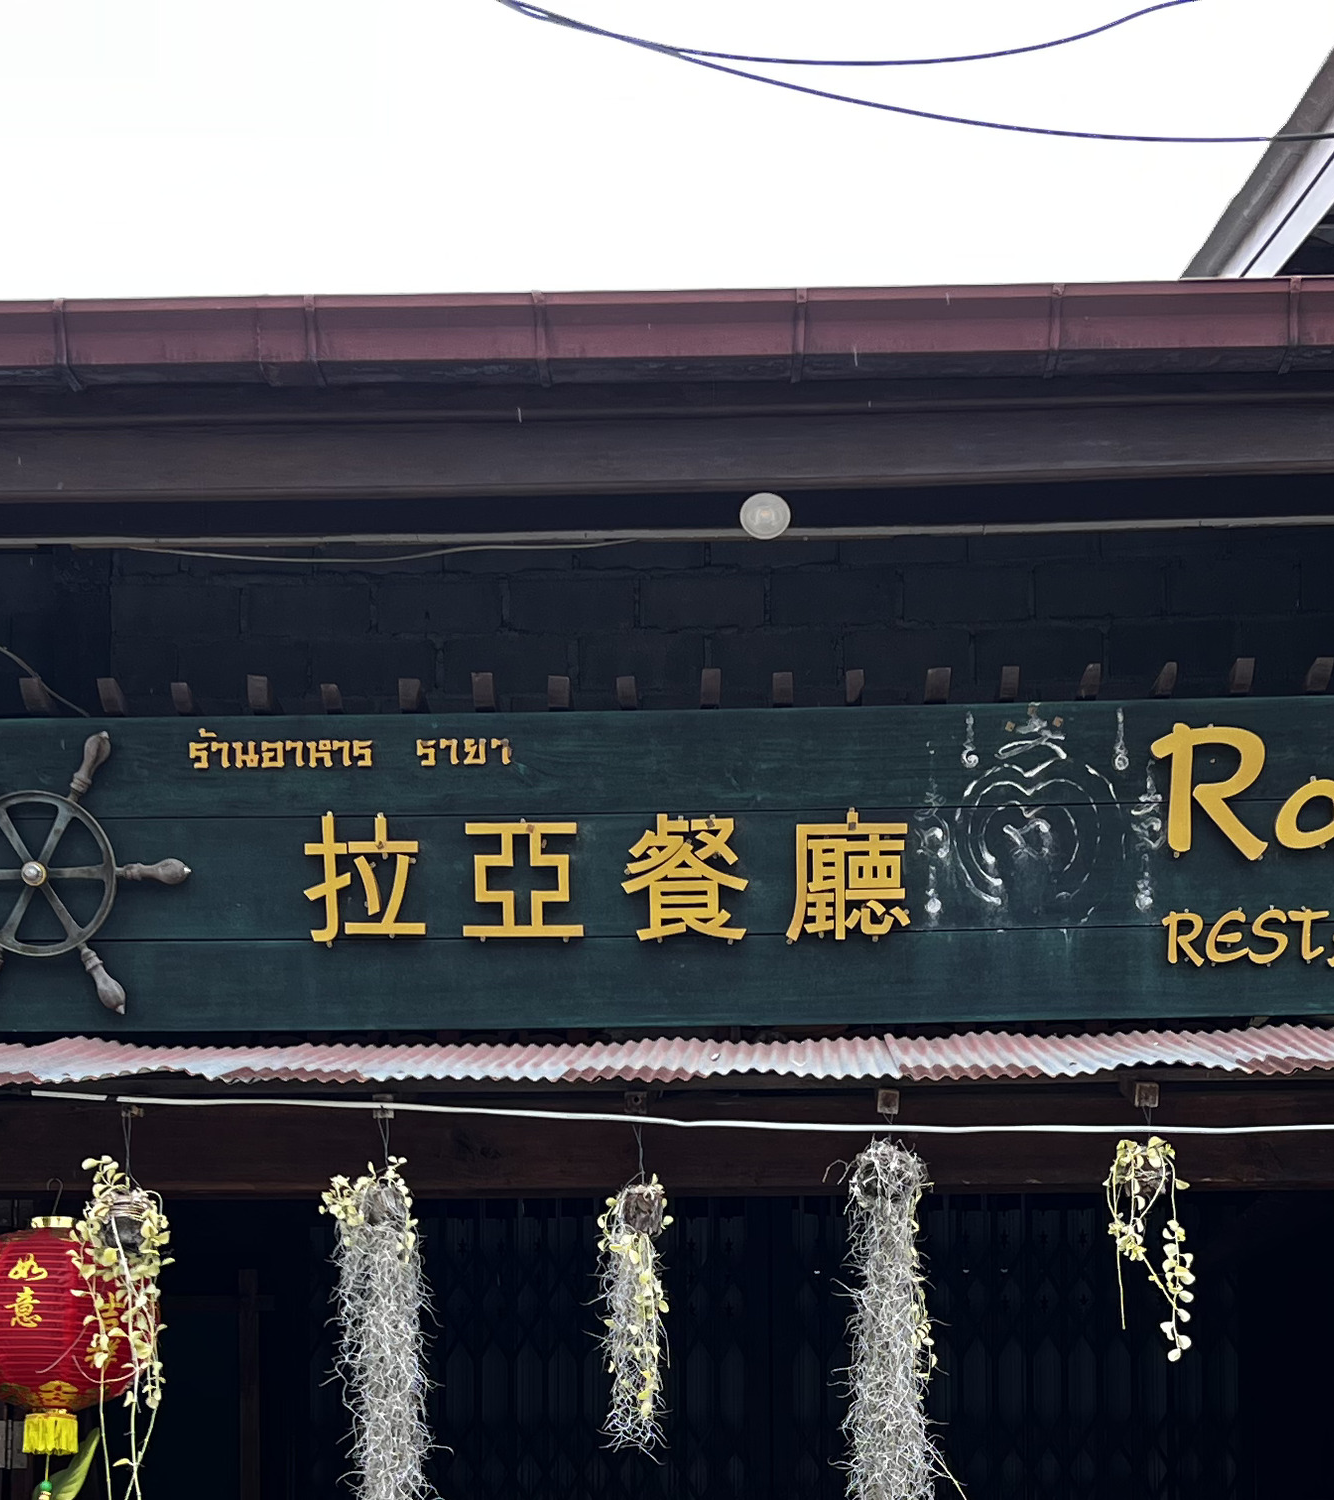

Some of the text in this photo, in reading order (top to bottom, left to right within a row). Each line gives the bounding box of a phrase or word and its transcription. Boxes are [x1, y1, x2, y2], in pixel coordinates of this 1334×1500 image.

[189, 728, 514, 769] ร้านอาหาร รายา
